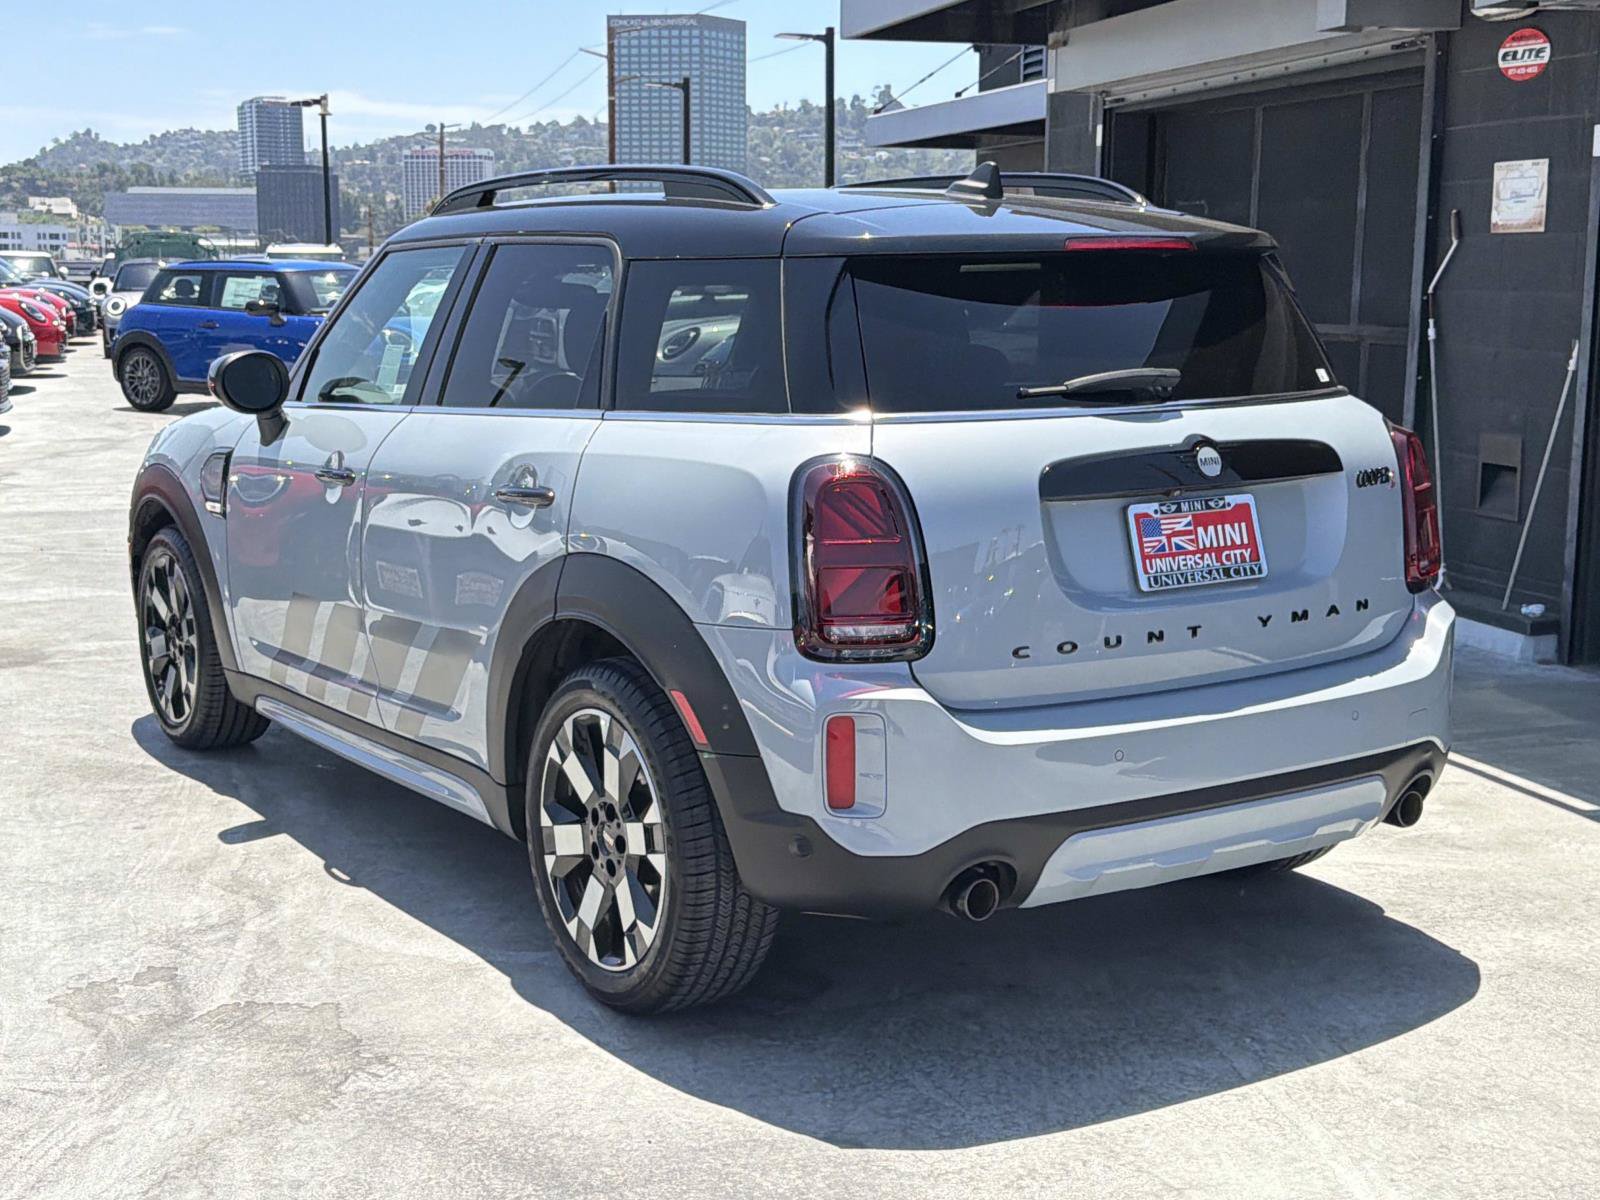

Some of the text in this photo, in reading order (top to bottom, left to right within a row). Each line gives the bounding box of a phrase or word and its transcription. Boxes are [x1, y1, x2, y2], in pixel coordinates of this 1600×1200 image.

[1500, 46, 1548, 62] ELITE
[1199, 456, 1220, 467] MINI
[1180, 500, 1206, 512] MINI
[1196, 522, 1249, 549] MINI
[1145, 548, 1252, 574] UNIVERSAL CITY
[1150, 564, 1261, 588] UNIVERSAL CITY
